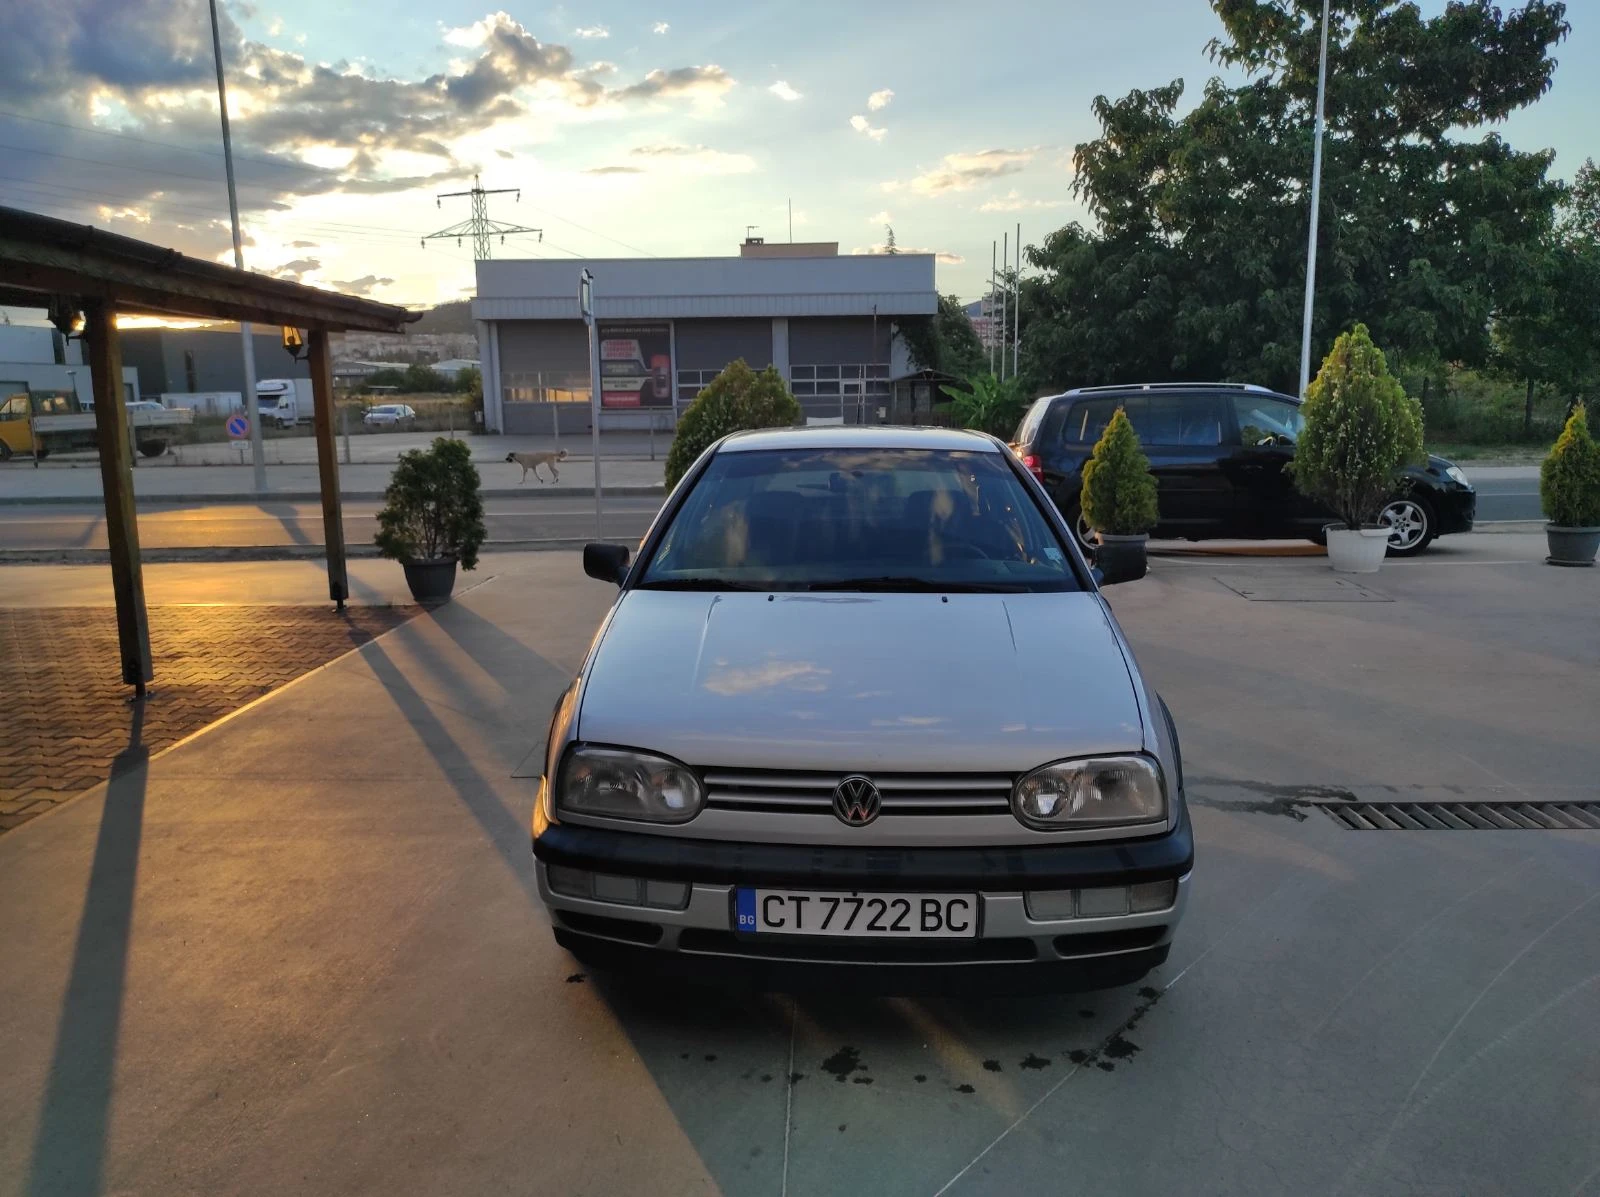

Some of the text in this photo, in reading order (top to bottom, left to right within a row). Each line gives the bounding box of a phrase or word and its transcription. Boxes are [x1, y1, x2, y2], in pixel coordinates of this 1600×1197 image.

[836, 779, 879, 823] VW
[739, 914, 755, 925] BG
[762, 895, 969, 932] CT 7722 BC
